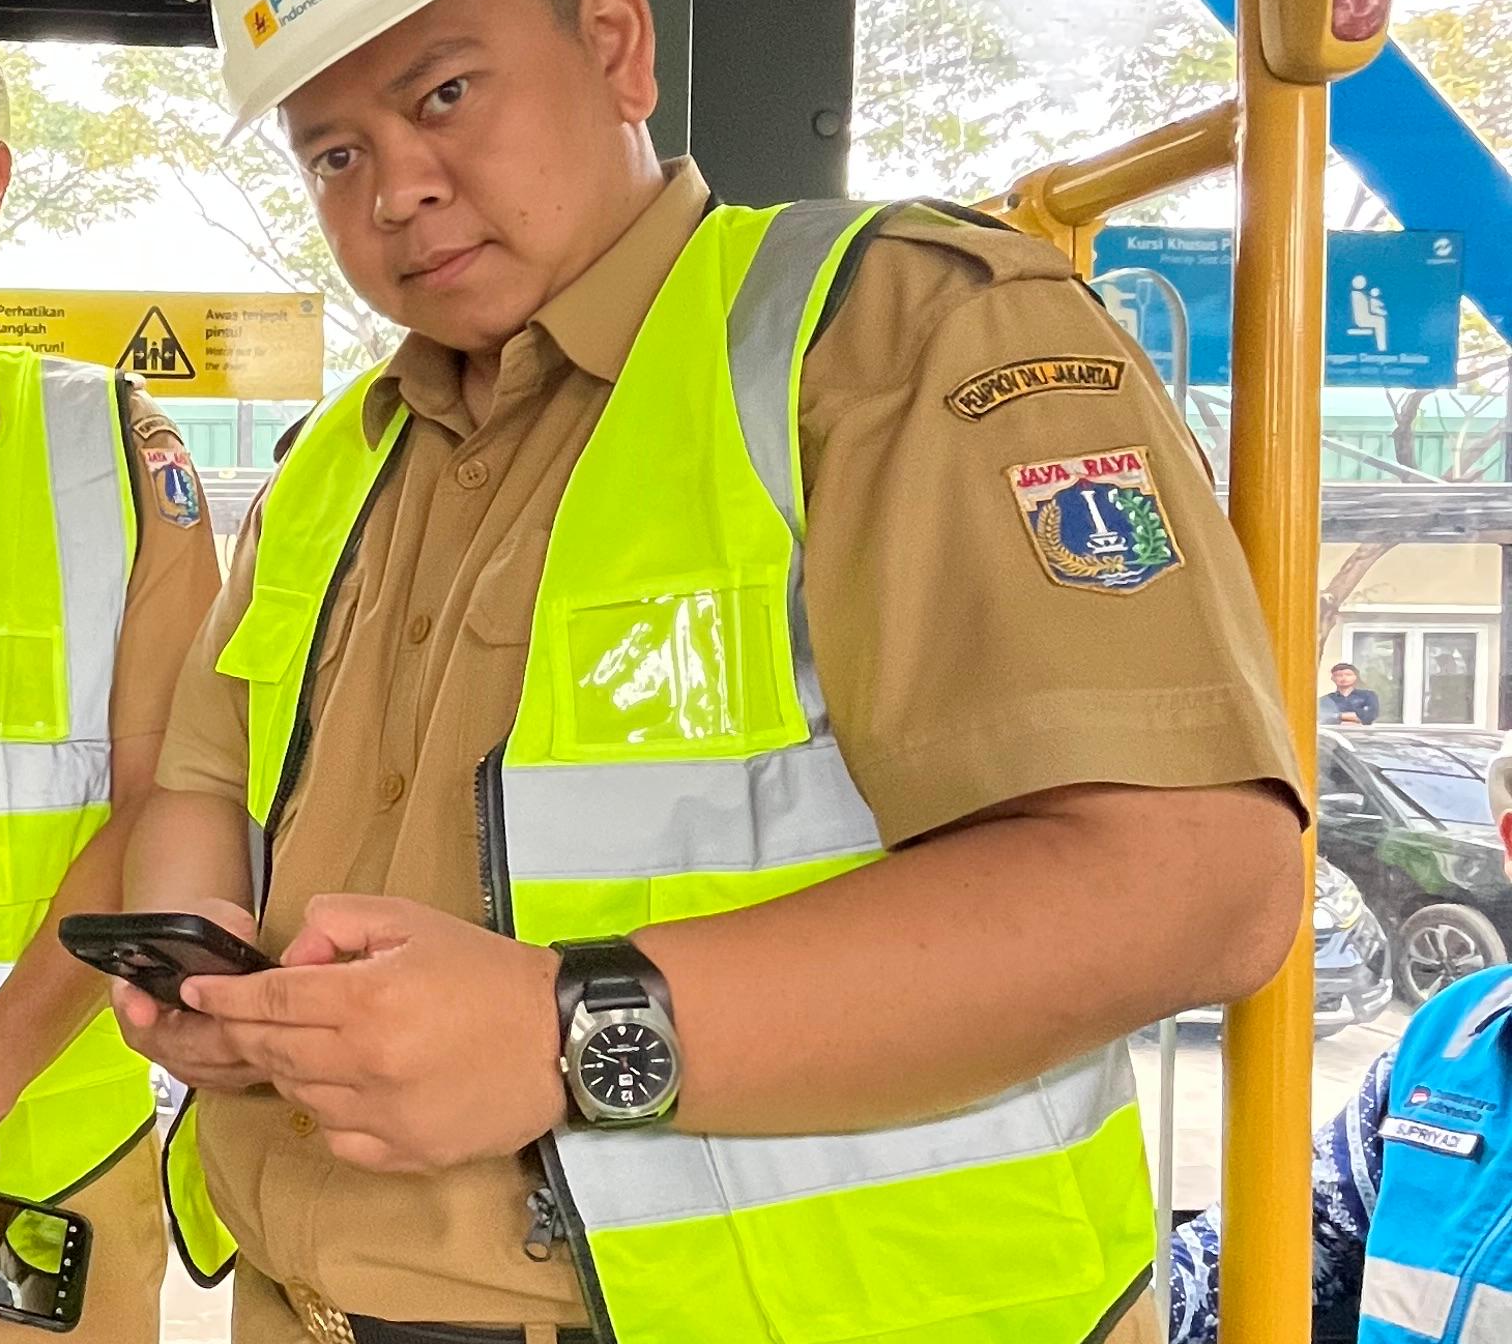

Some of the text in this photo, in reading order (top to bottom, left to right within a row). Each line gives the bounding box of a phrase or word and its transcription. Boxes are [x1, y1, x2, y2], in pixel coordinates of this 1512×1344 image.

[1127, 236, 1163, 250] Kursi
[1167, 237, 1218, 251] Khusus
[206, 308, 238, 321] Awas
[206, 326, 242, 341] pintu!
[1017, 366, 1049, 388] DKI
[1050, 363, 1113, 387] JAKARTA
[1016, 452, 1143, 488] JAYA RAYA
